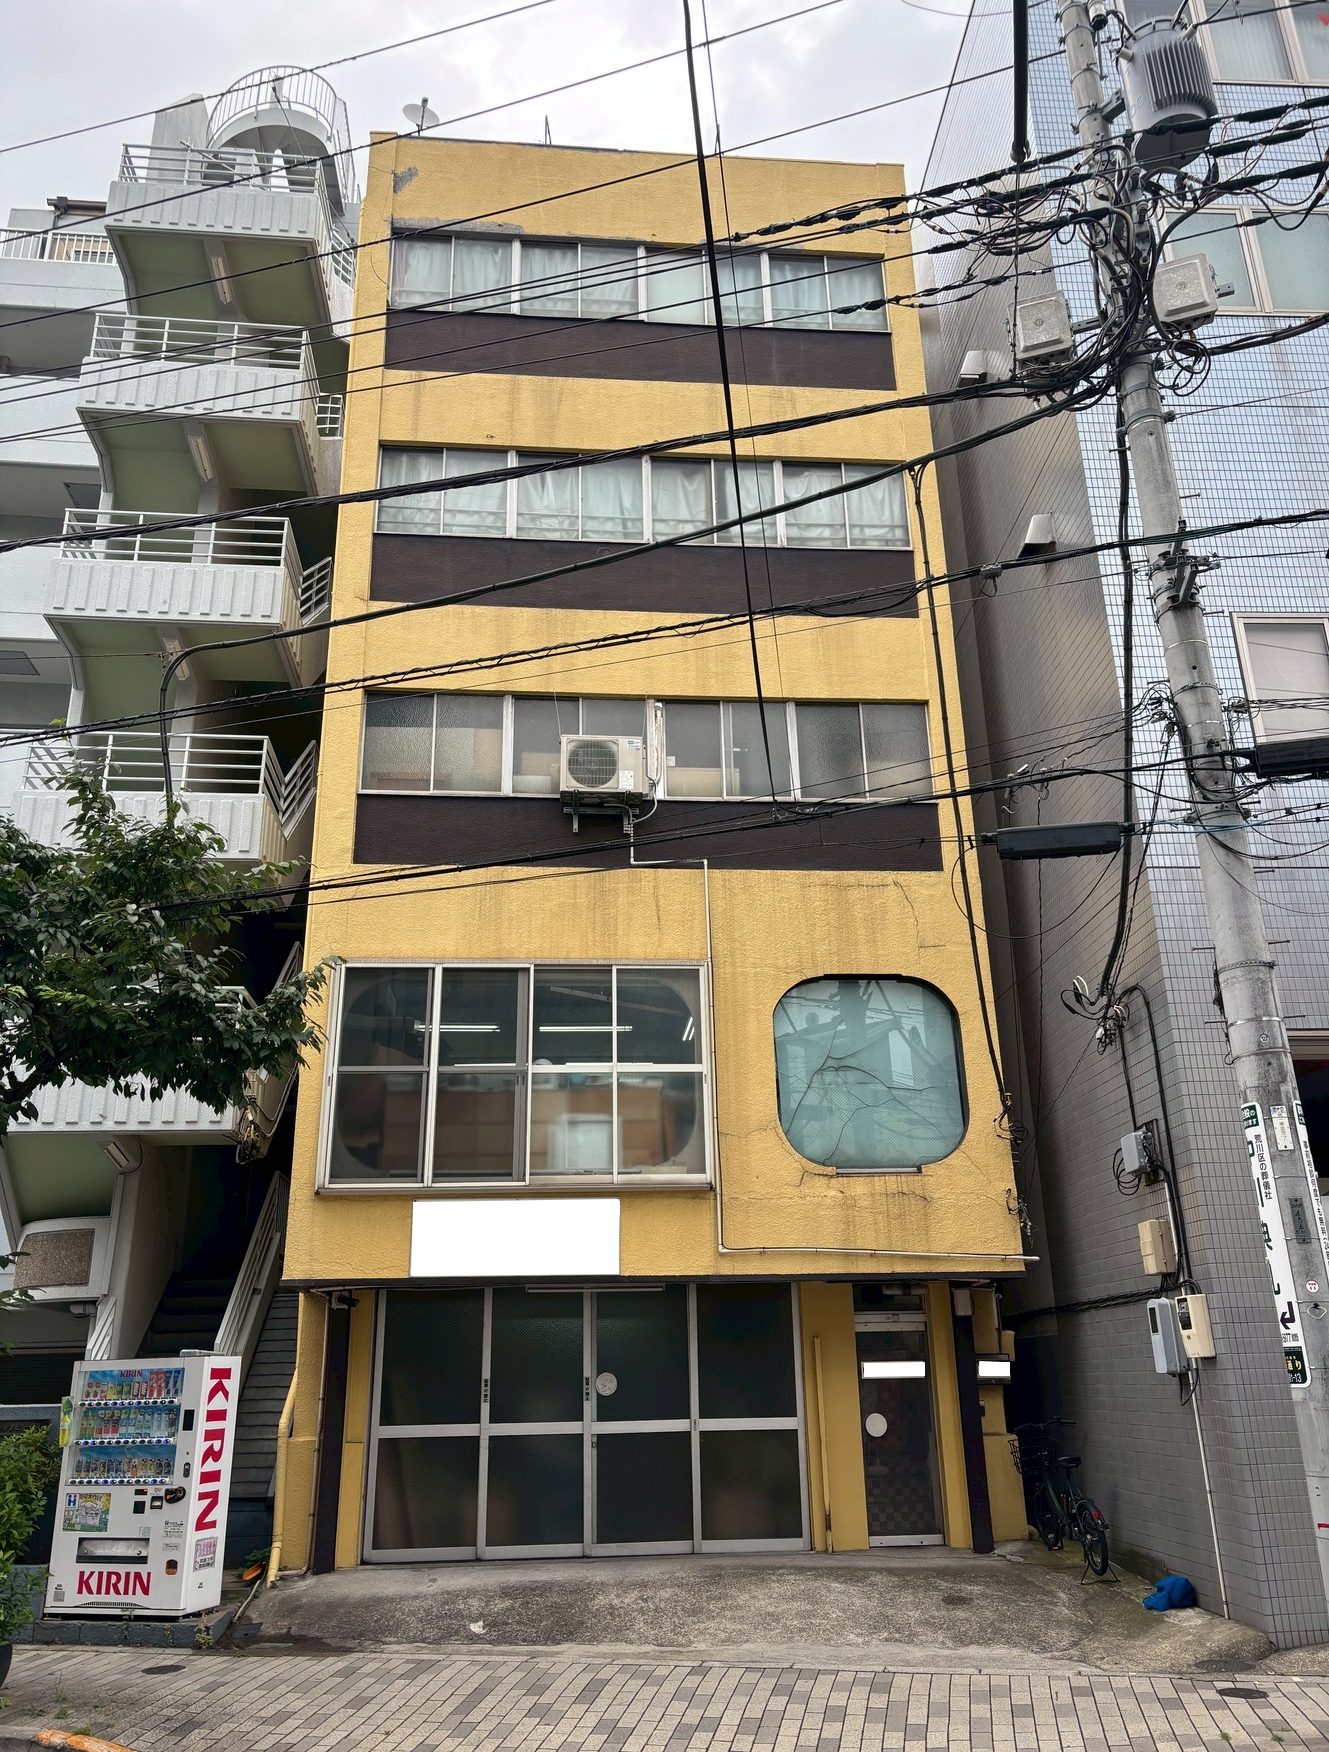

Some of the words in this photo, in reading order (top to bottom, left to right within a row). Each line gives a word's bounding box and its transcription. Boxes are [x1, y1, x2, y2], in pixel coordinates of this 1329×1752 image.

[1254, 1134, 1273, 1200] 荒川区の葬儀社
[120, 1370, 143, 1378] KIRIN
[195, 1367, 232, 1532] KIRIN
[77, 1571, 152, 1597] KIRIN
